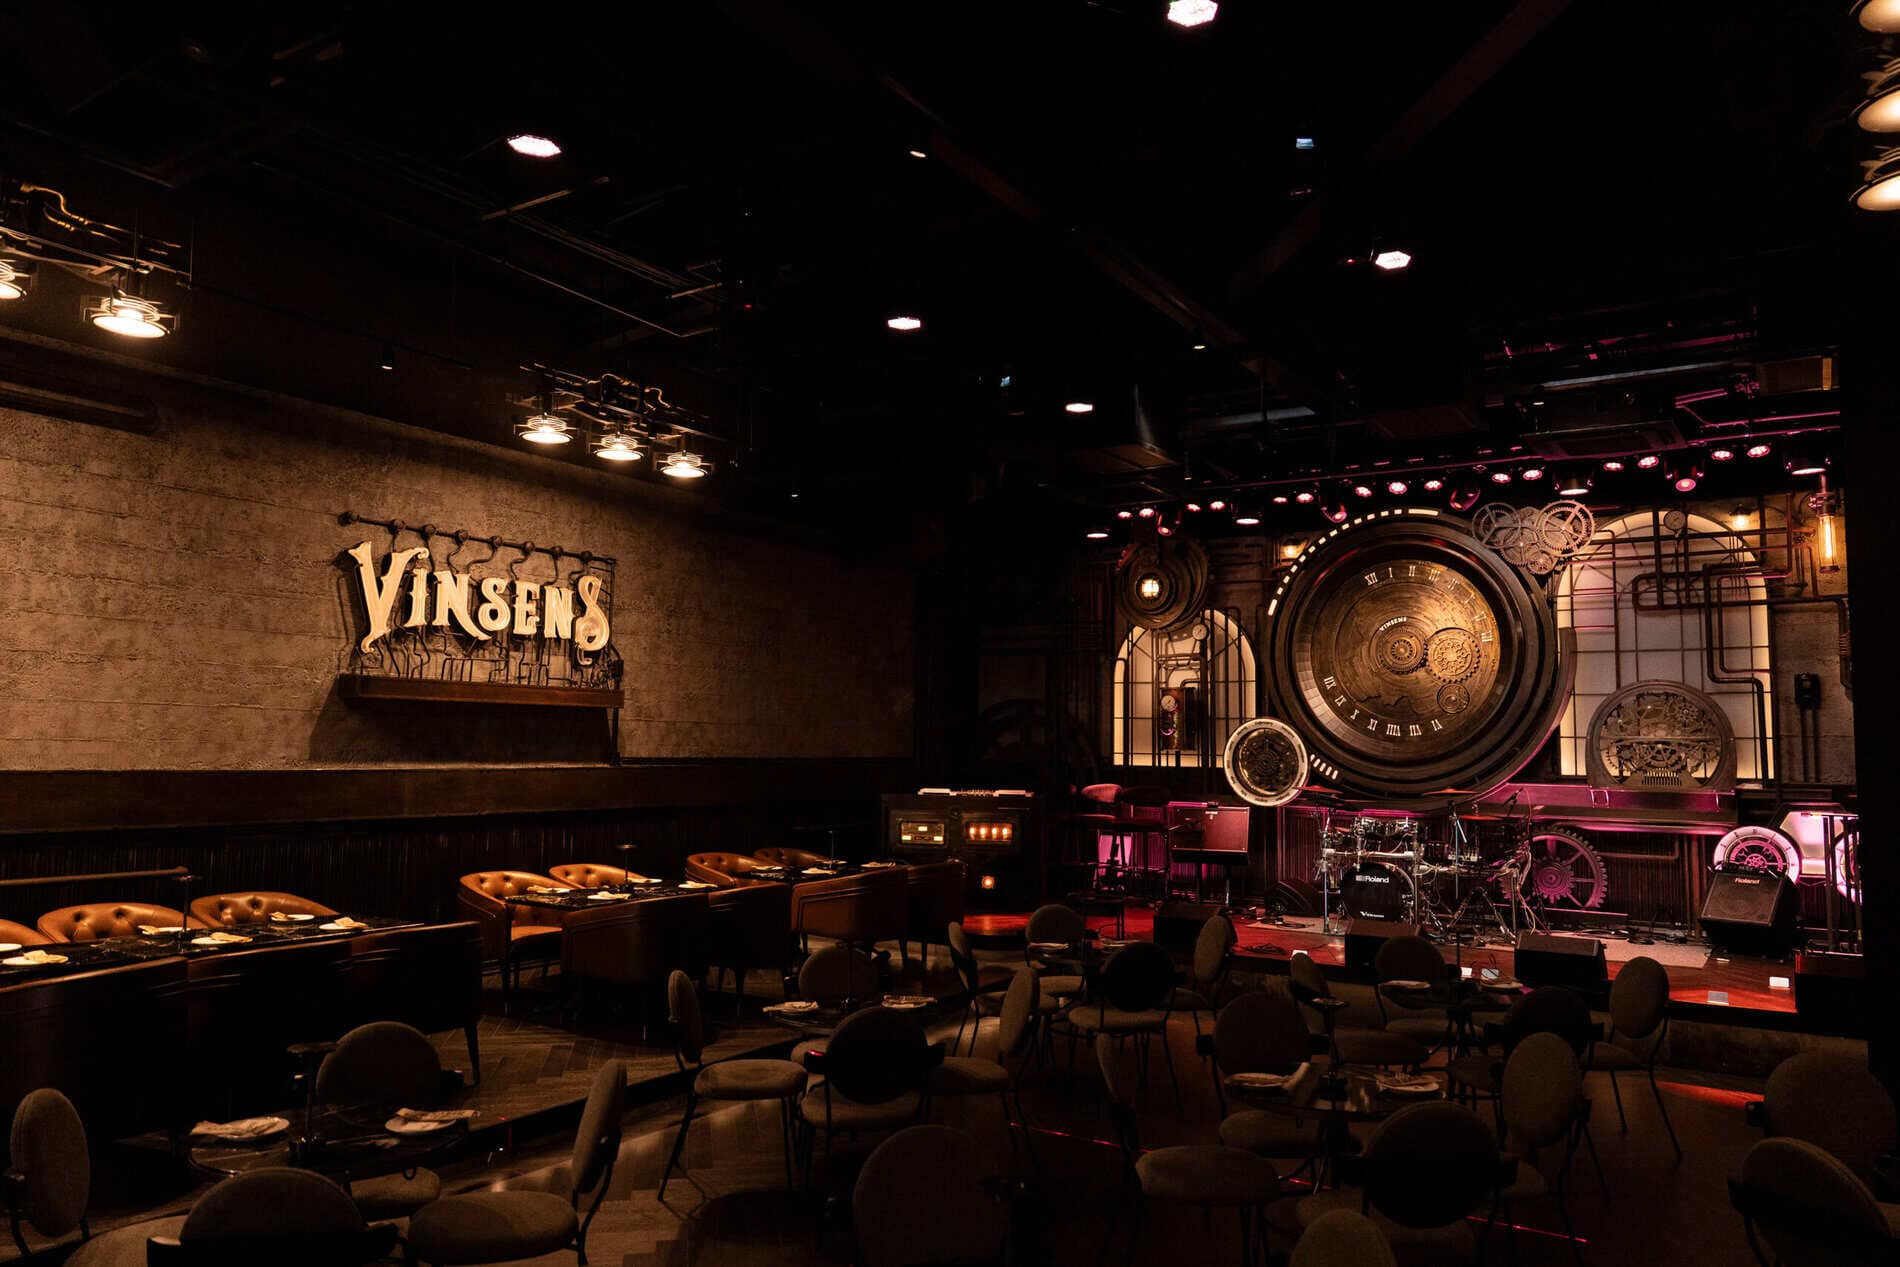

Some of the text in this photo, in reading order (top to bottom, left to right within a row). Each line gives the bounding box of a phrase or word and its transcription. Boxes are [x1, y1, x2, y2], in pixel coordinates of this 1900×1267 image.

[1364, 571, 1378, 586] XII
[348, 541, 610, 665] VINSENS
[1350, 709, 1360, 720] X
[1365, 875, 1390, 884] Roland
